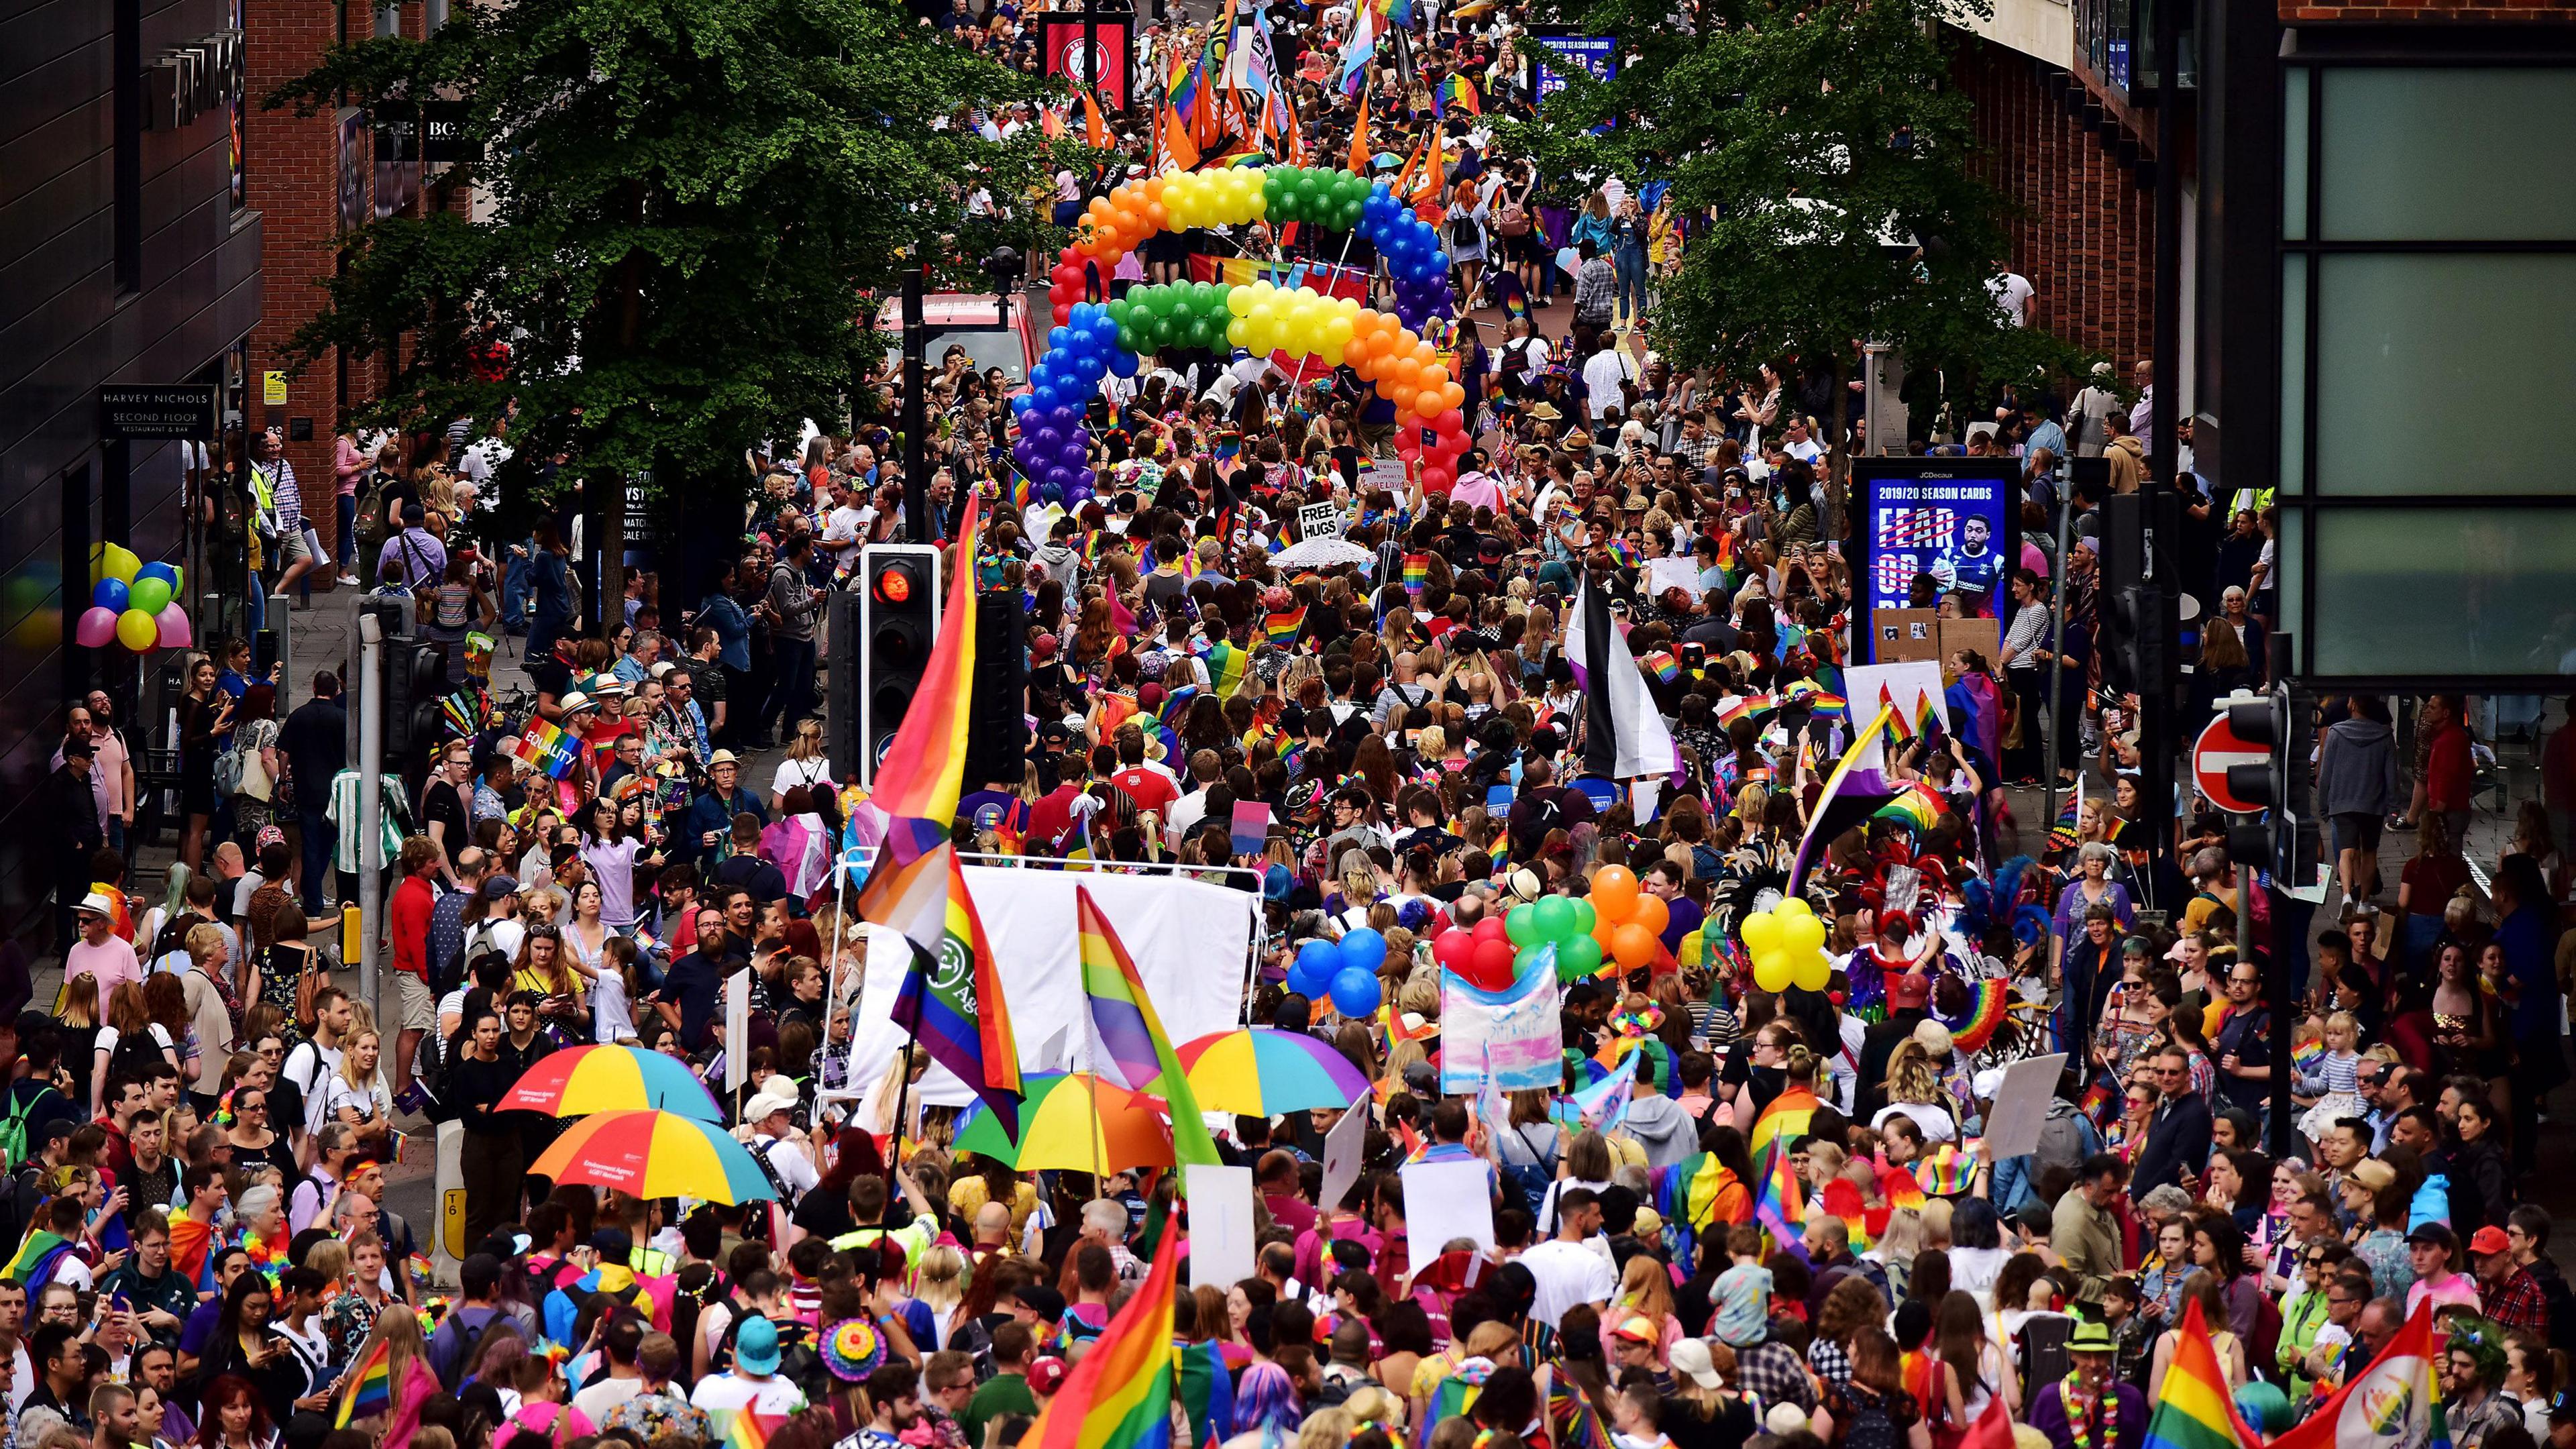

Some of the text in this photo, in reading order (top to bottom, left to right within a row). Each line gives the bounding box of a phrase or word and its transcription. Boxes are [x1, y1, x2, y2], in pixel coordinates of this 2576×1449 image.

[1567, 42, 1589, 50] SEASON
[1590, 42, 1609, 50] CARDS
[103, 394, 207, 403] HARVEY NICHOLS
[113, 413, 198, 422] SECOND FLOOR
[1879, 487, 1992, 500] 2019/20 SEASON CARDS
[1301, 504, 1334, 523] FREE
[1304, 520, 1336, 539] HUGS
[1878, 507, 1955, 548] FEAR
[1957, 580, 1985, 590] TOOGOOD
[525, 730, 577, 765] EQUALITY
[584, 1159, 635, 1177] Environment Agency
[588, 1168, 625, 1181] LGBT Network
[448, 1194, 456, 1203] T
[449, 1205, 457, 1216] 6
